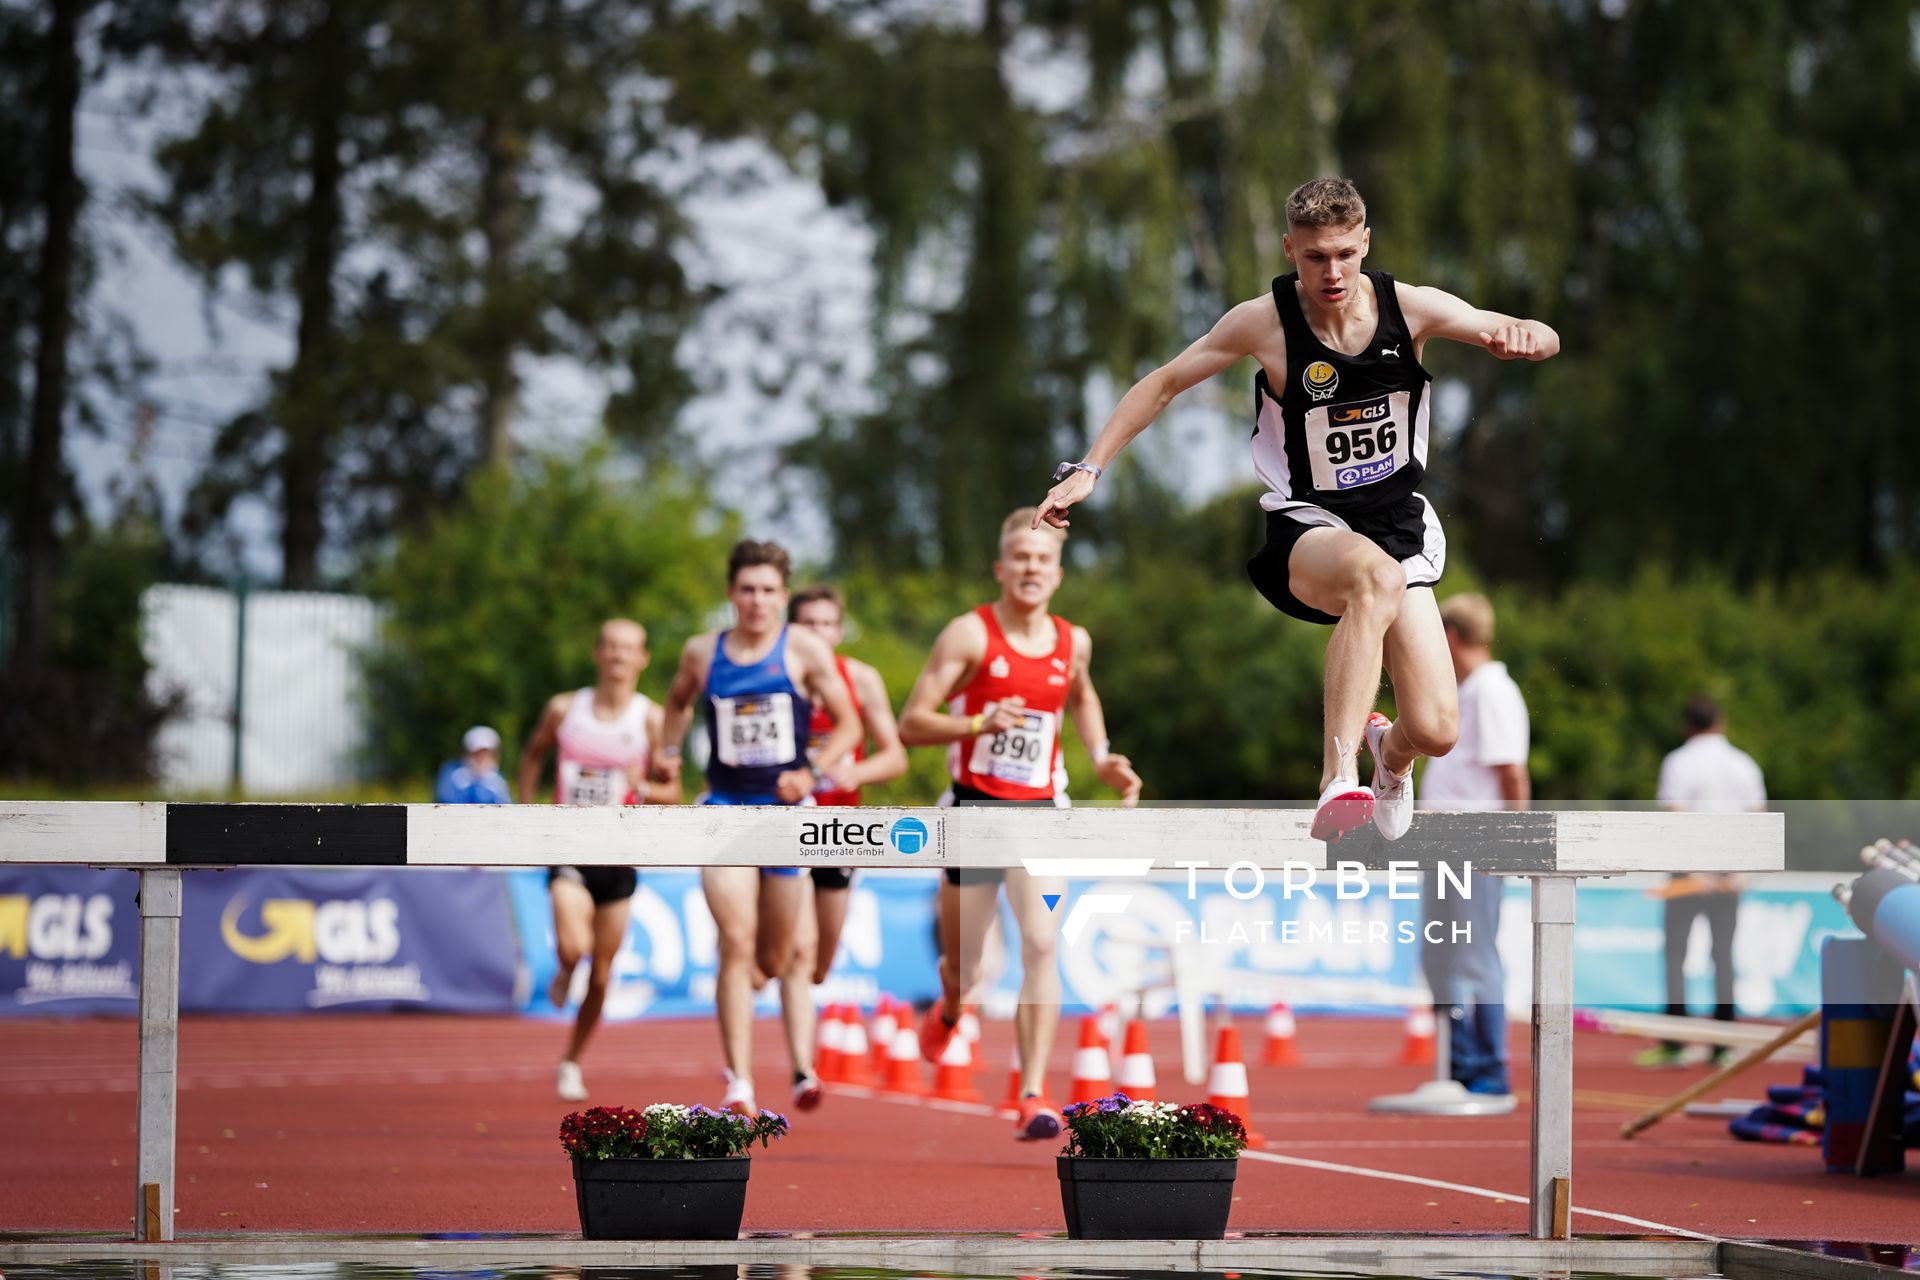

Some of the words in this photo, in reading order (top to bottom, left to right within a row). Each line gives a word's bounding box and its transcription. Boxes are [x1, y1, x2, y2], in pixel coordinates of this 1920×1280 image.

[1361, 403, 1386, 419] GLS
[1326, 421, 1397, 465] 956
[1361, 458, 1393, 477] PLAN
[991, 733, 1041, 762] 890
[800, 818, 884, 846] artec
[800, 847, 854, 858] Sportgeräte
[857, 848, 884, 856] GmbH
[28, 894, 115, 960] GLS
[314, 897, 400, 964] GLS
